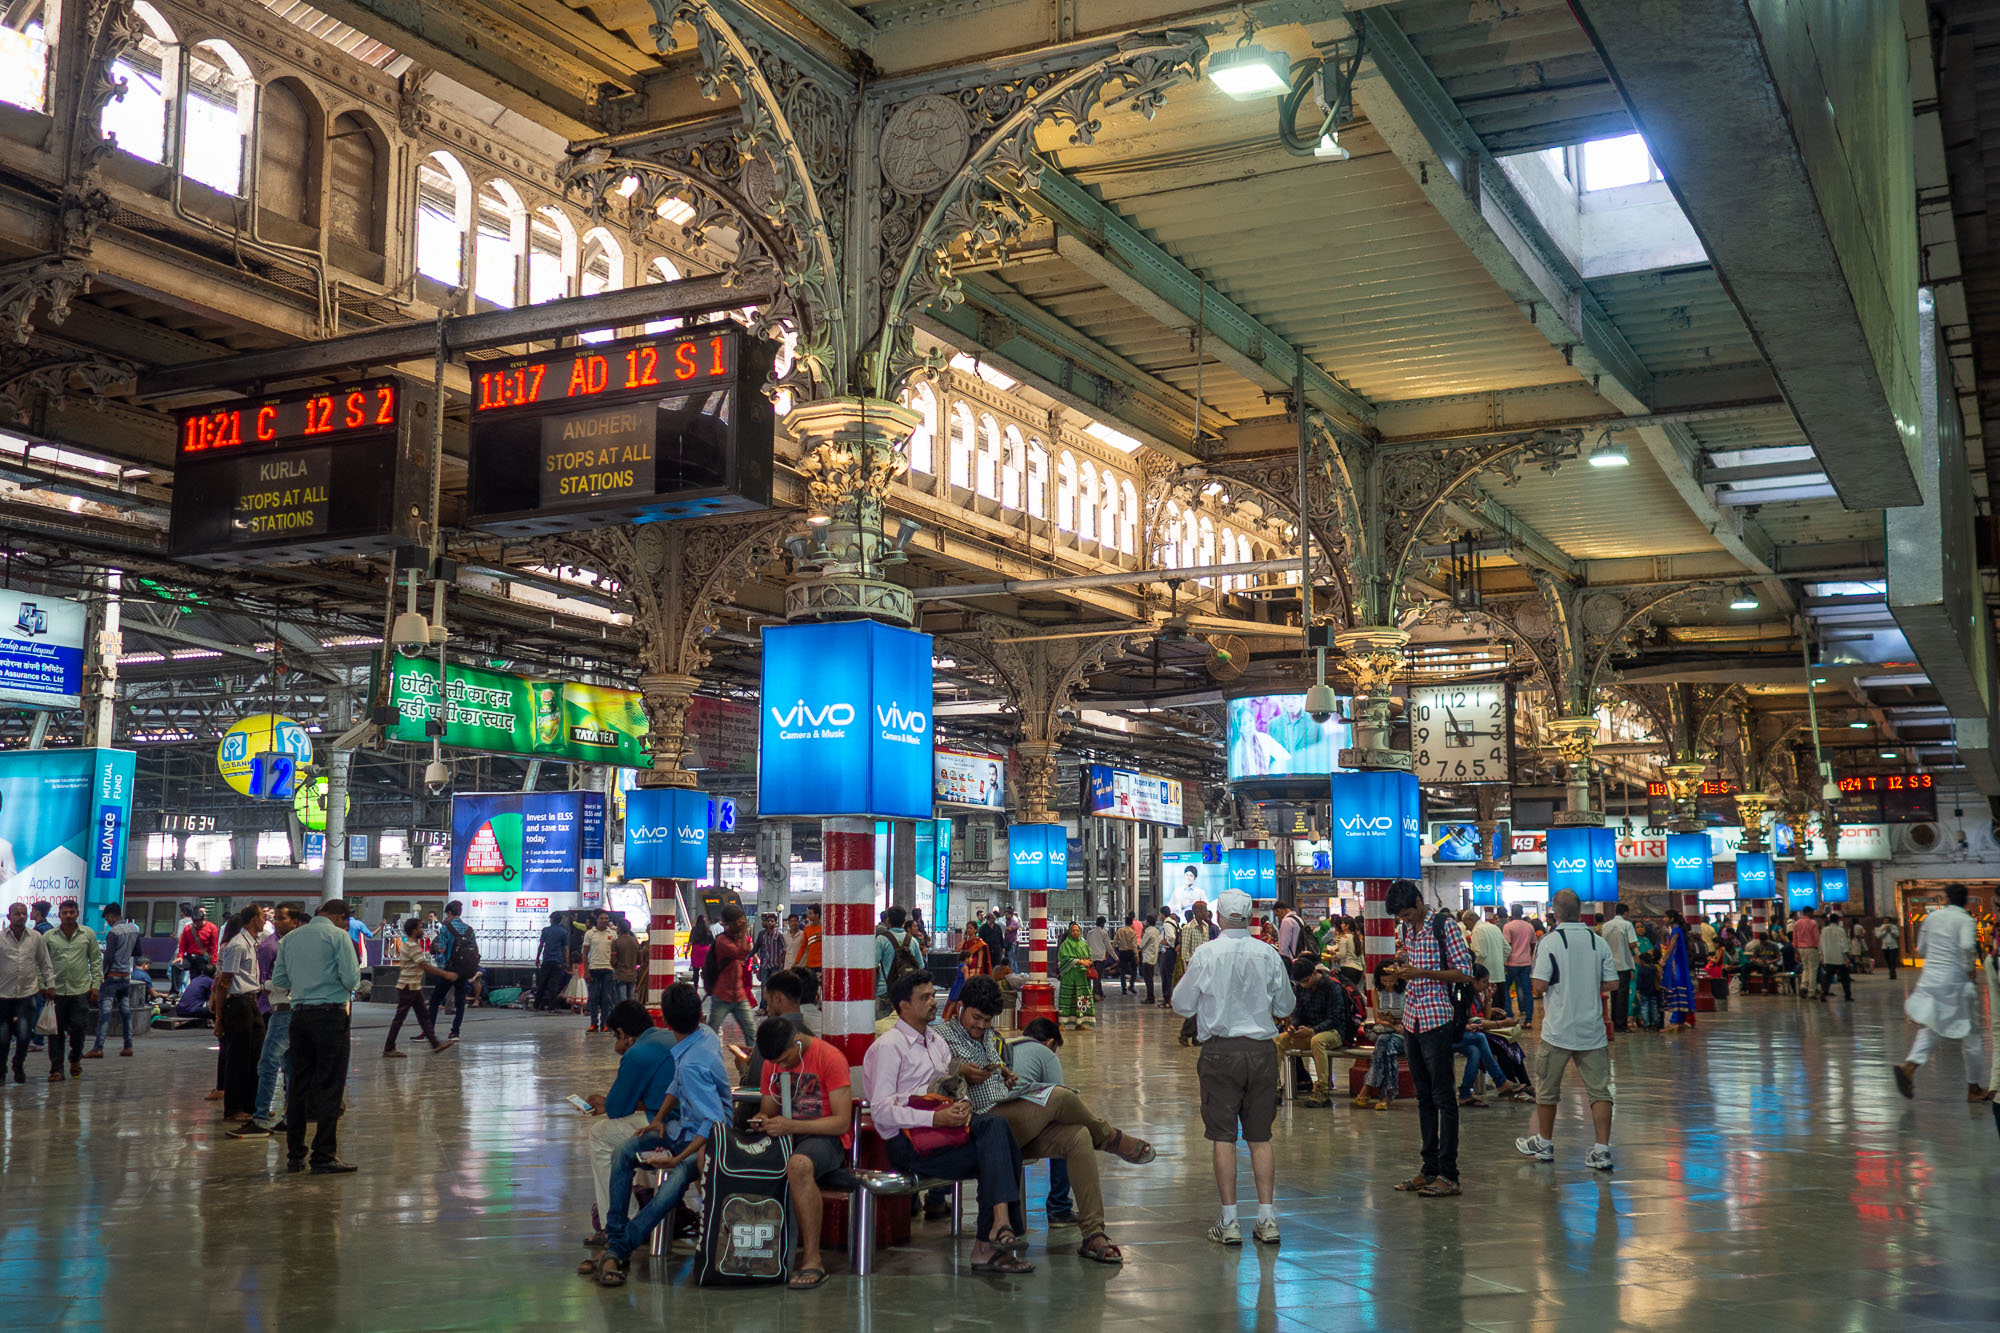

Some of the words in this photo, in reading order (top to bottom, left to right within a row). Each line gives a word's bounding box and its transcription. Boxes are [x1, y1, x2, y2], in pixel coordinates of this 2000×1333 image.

[480, 364, 546, 410] 11:17
[567, 355, 608, 397] AD
[625, 347, 659, 389] 12
[674, 342, 697, 380] S
[709, 336, 726, 376] 1
[184, 410, 242, 452] 11:21
[256, 406, 277, 441] C
[304, 396, 334, 436] 12
[346, 392, 366, 429] S
[376, 388, 393, 425] 2
[563, 414, 637, 441] ANDHERI
[546, 450, 594, 472] STOPS
[598, 448, 618, 466] AT
[622, 443, 652, 463] ALL
[260, 463, 308, 482] KURLA
[560, 470, 634, 495] STATIONS
[239, 491, 281, 512] STOPS
[282, 490, 300, 509] AT
[303, 486, 328, 505] ALL
[250, 510, 314, 533] STATIONS
[4, 670, 40, 680] Assurance
[41, 674, 52, 682] Co.
[400, 671, 435, 696] छोटी
[468, 686, 488, 703] का
[489, 689, 512, 708] दम
[1435, 693, 1444, 708] 11
[1451, 692, 1466, 708] 12
[460, 707, 481, 725] का
[771, 699, 855, 727] vivo
[876, 701, 926, 733] vivo
[1417, 706, 1430, 722] 10
[1490, 702, 1501, 718] 2
[574, 728, 598, 742] TATA
[600, 731, 614, 744] TEA
[780, 730, 811, 740] Camera
[812, 730, 820, 738] &
[822, 729, 845, 738] Music
[882, 731, 900, 742] Camera
[906, 734, 920, 744] Music
[1418, 728, 1430, 744] 9
[1490, 724, 1502, 740] 3
[1419, 750, 1430, 766] 8
[1490, 746, 1502, 764] 4
[1436, 760, 1448, 777] 7
[1454, 760, 1466, 776] 6
[1473, 760, 1486, 776] 5
[103, 762, 113, 799] MUTUAL
[268, 757, 293, 796] 2
[1839, 778, 1862, 791] 1:24
[1867, 778, 1876, 790] T
[1888, 776, 1903, 790] 12
[1908, 776, 1918, 788] S
[1921, 774, 1931, 788] 3
[114, 774, 122, 800] FUND
[1649, 782, 1668, 796] 11:1
[1720, 781, 1728, 794] S
[557, 812, 573, 820] ELSS
[720, 800, 735, 830] 3
[1340, 814, 1392, 829] vivo
[1403, 815, 1418, 831] vivo
[165, 816, 177, 830] 11
[184, 816, 196, 830] 16
[199, 816, 215, 831] 34
[630, 825, 668, 838] vivo
[678, 824, 704, 839] vivo
[415, 831, 425, 842] 11
[430, 832, 439, 844] 16
[526, 835, 546, 844] today.
[1514, 838, 1534, 850] K9
[1013, 850, 1043, 860] vivo
[1049, 850, 1065, 861] vivo
[1203, 844, 1212, 862] 5
[1672, 856, 1702, 864] vivo
[1552, 857, 1586, 868] vivo
[1594, 857, 1614, 868] vivo
[1232, 868, 1256, 876] vivo
[1261, 868, 1274, 876] vivo
[29, 876, 60, 892] Aapka
[64, 876, 80, 889] Tax
[733, 1224, 774, 1248] SP
